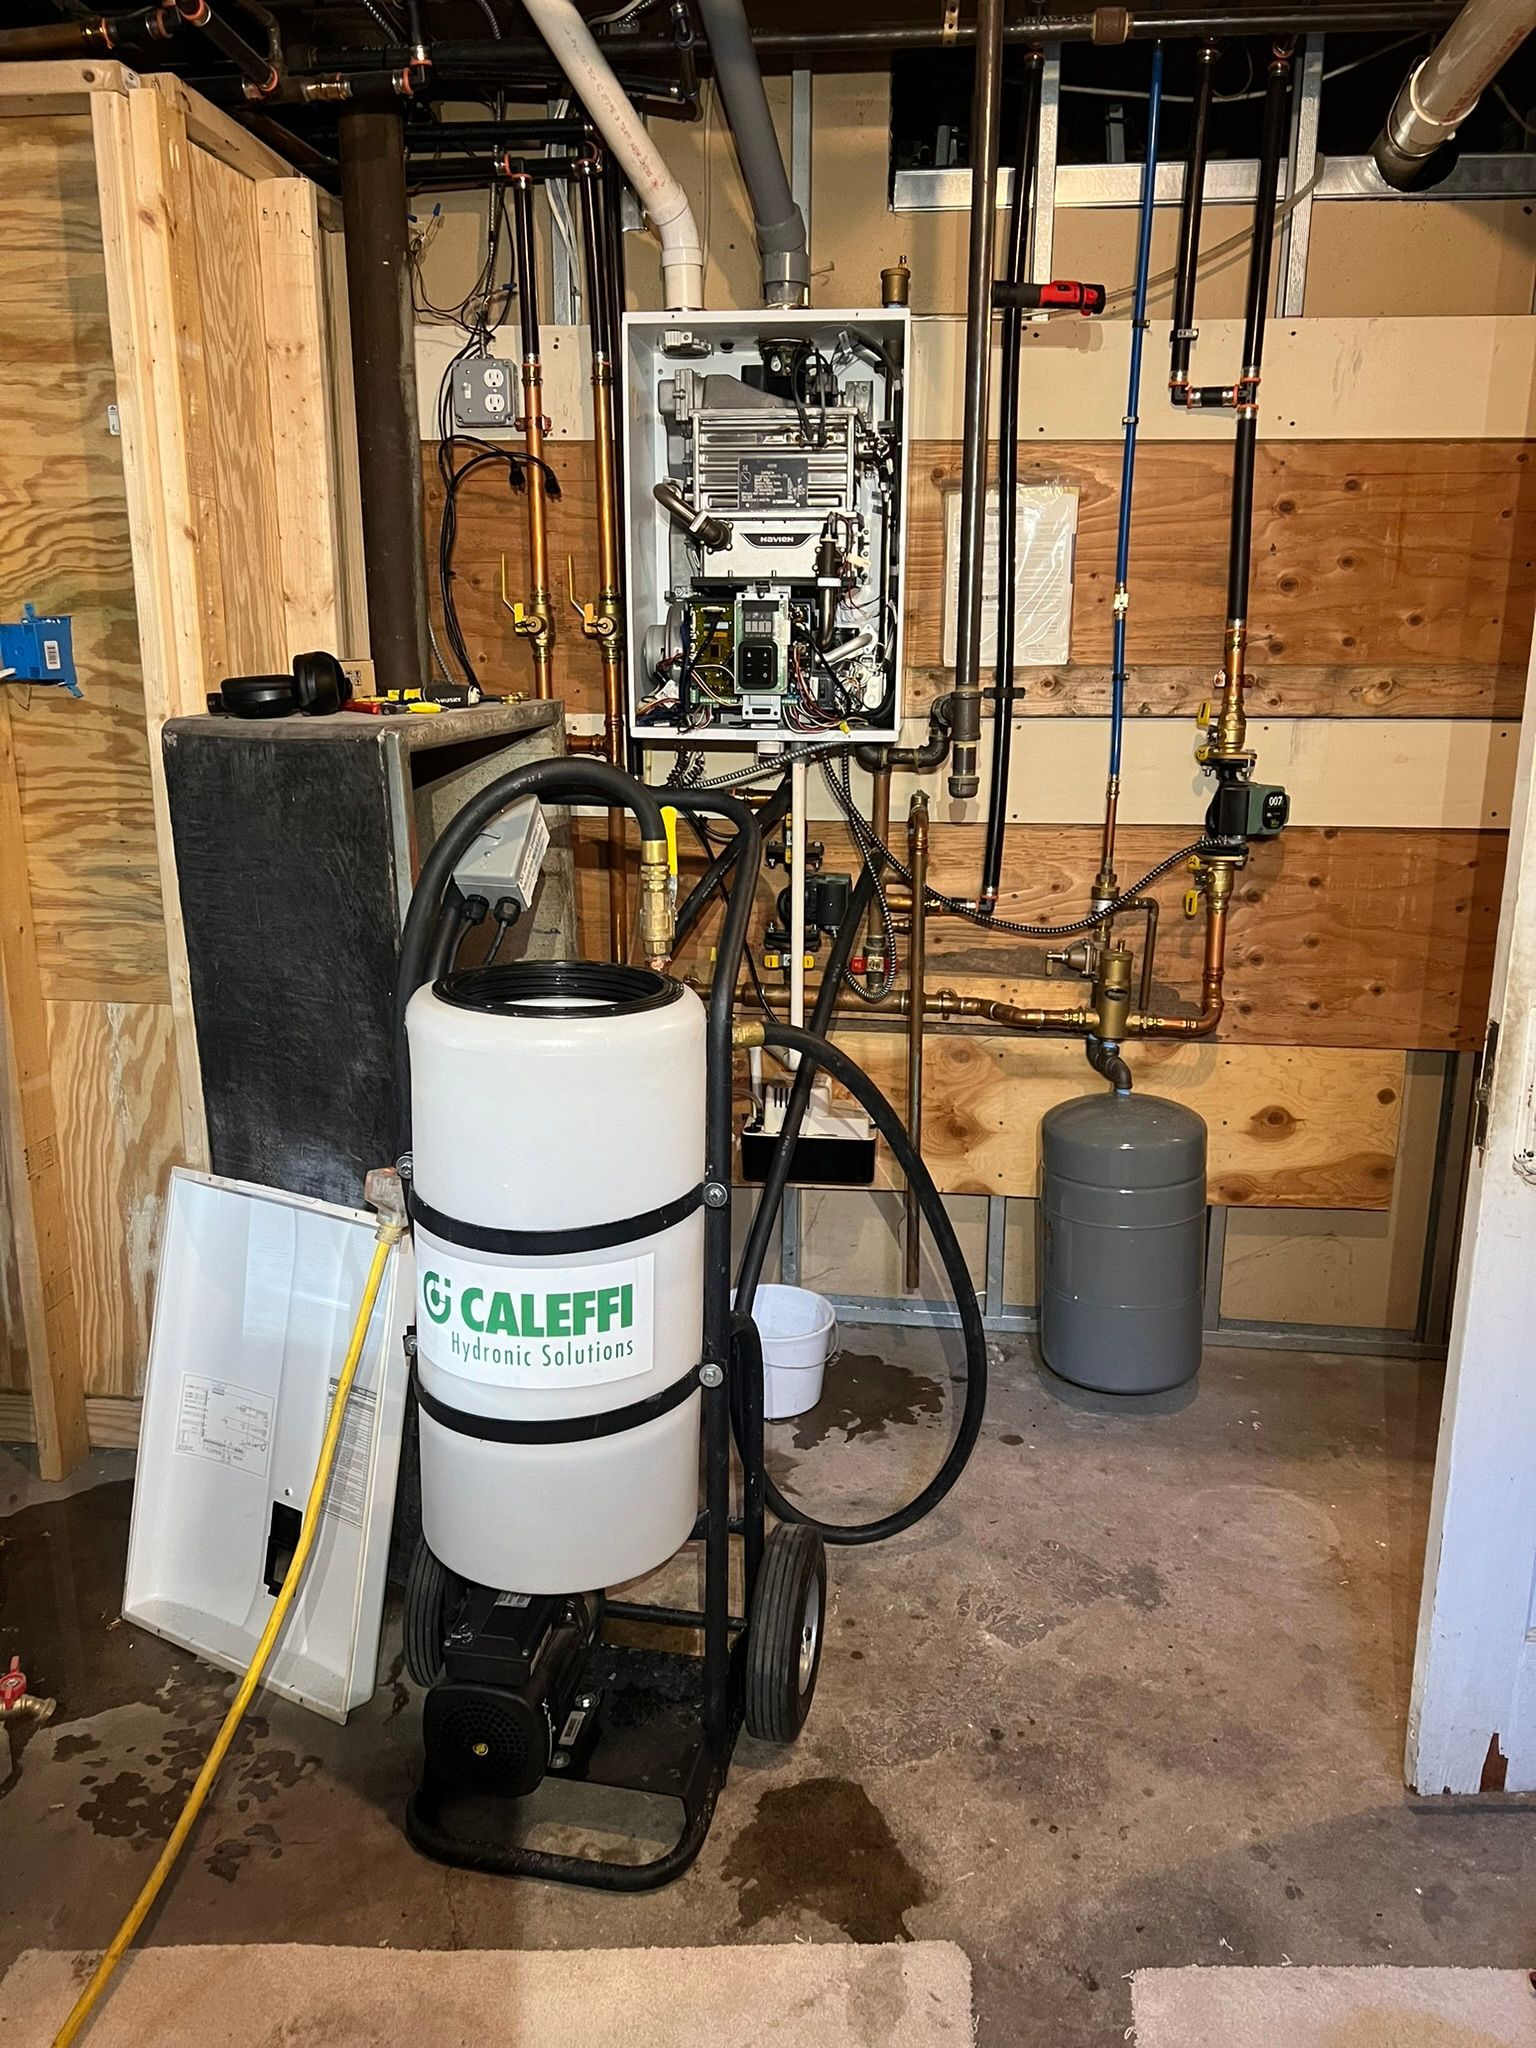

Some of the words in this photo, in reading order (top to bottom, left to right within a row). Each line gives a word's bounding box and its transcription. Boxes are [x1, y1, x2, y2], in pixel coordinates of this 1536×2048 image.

[440, 696, 462, 704] HUSKY
[1268, 796, 1283, 807] 007
[461, 1283, 633, 1337] CALEFFI
[451, 1331, 532, 1367] Hydronic
[542, 1339, 634, 1367] Solutions
